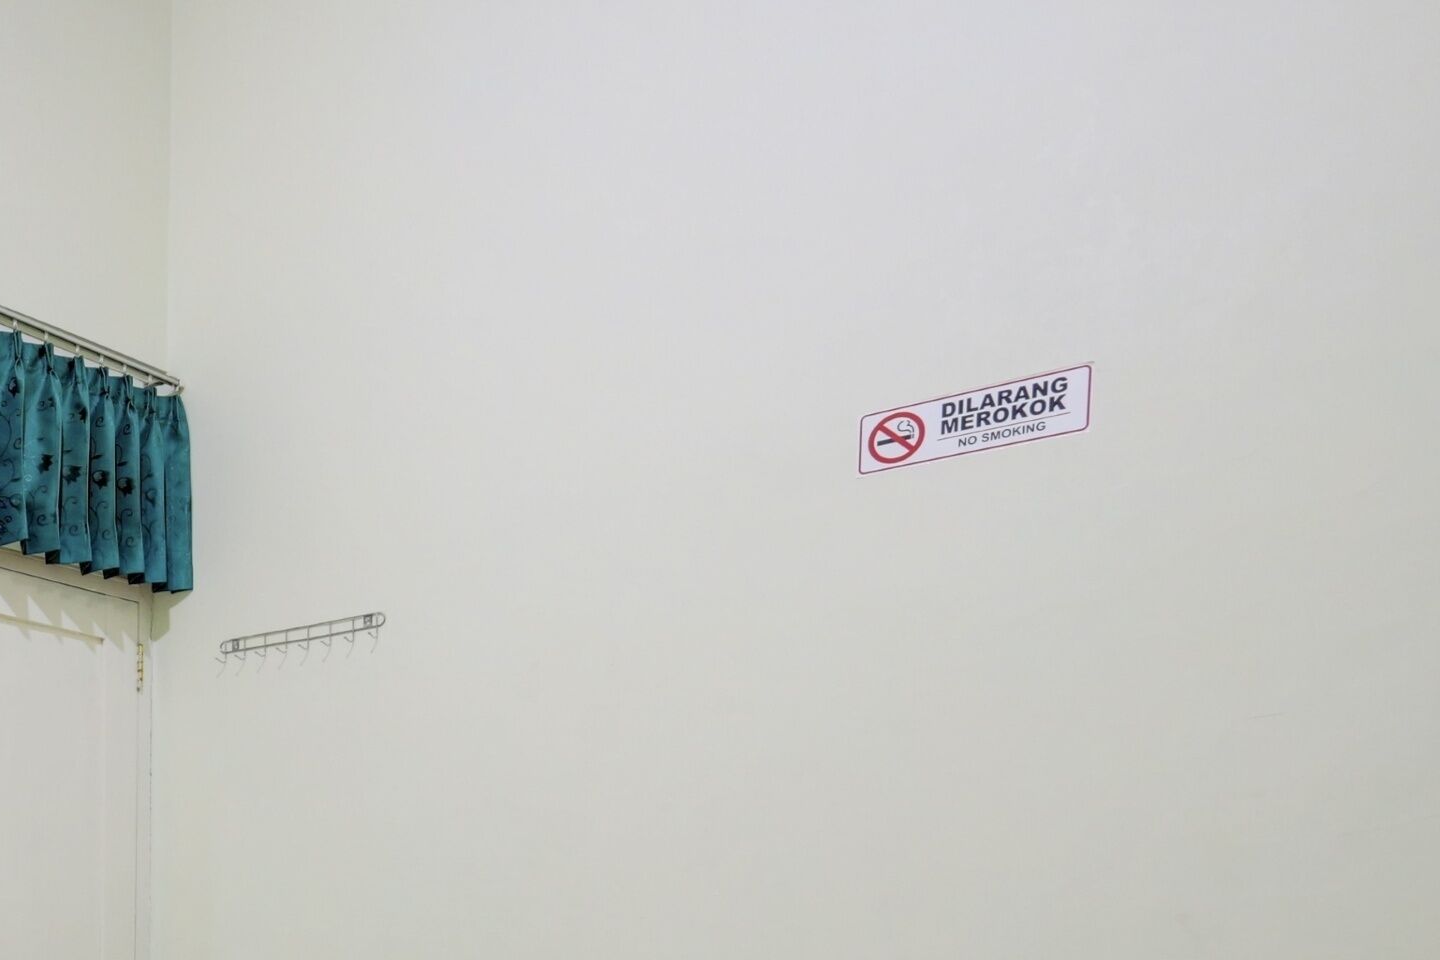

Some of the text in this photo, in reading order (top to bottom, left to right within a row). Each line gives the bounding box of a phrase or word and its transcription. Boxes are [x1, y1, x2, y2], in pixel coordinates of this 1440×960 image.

[941, 394, 1066, 435] MEROKOK
[942, 376, 1068, 418] DILARANG
[958, 421, 1046, 448] NO SMOKING
